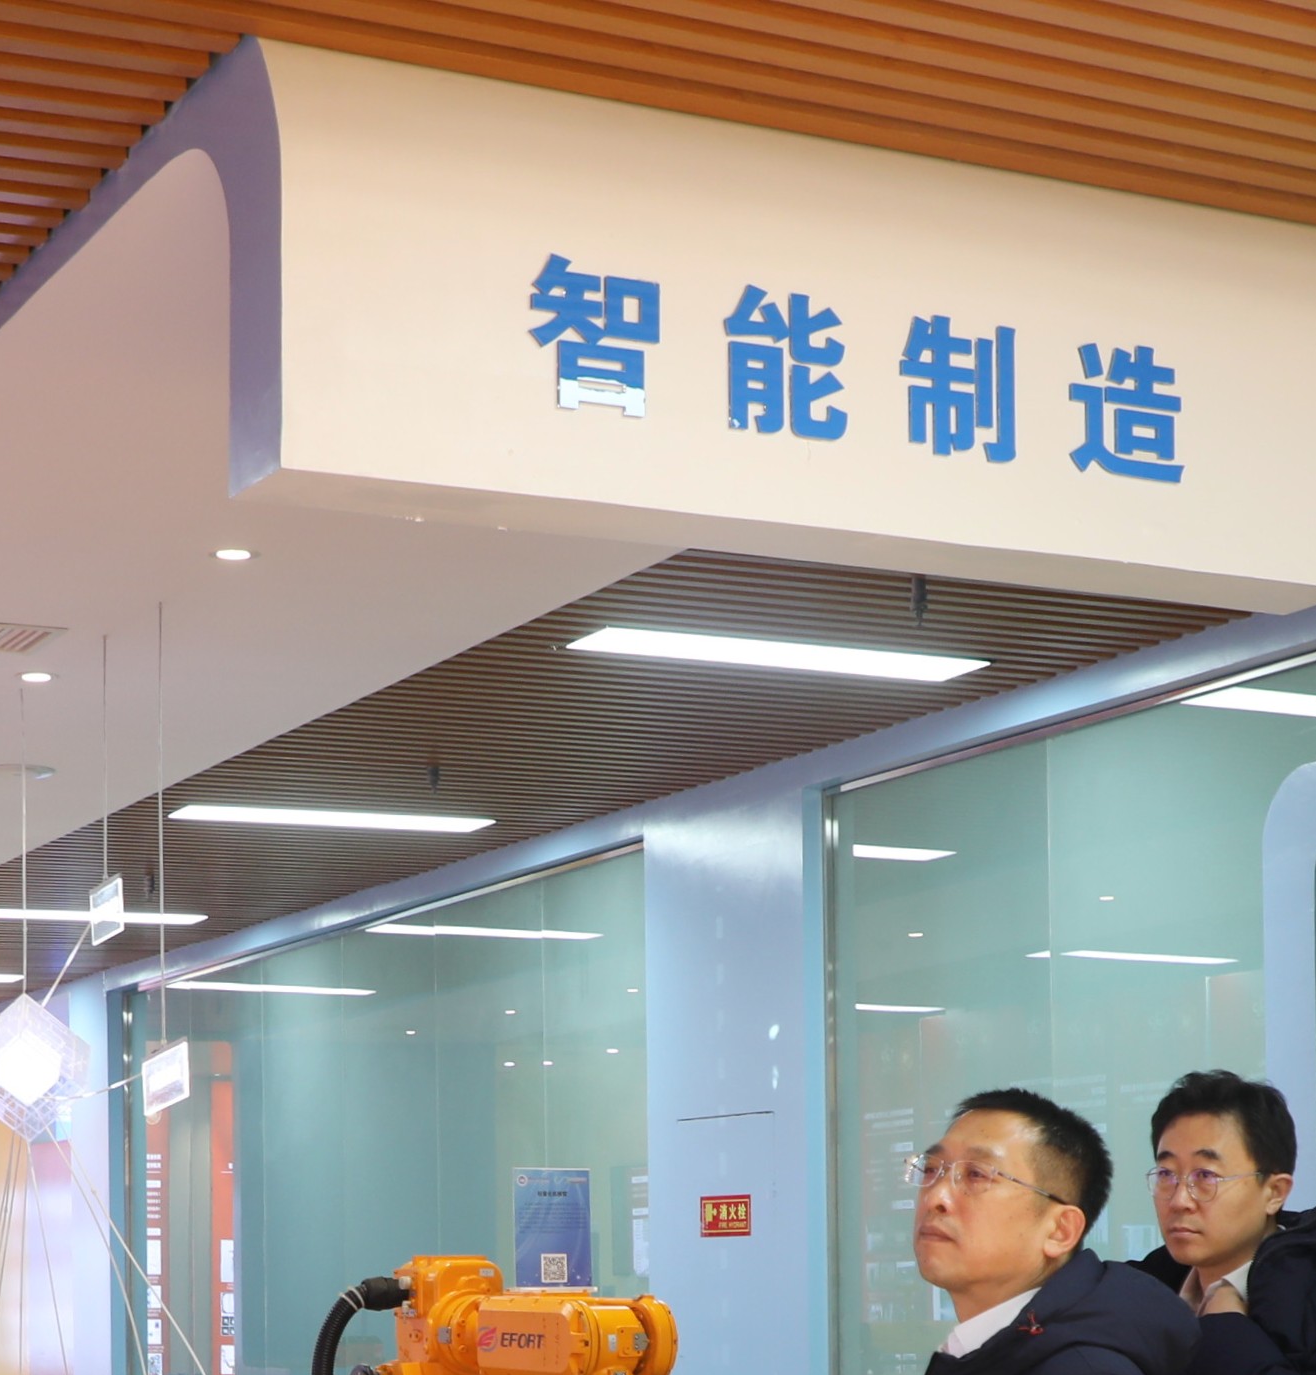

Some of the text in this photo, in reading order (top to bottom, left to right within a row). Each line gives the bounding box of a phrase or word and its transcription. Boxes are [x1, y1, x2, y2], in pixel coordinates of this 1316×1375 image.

[529, 253, 1185, 484] 智能制造
[719, 1203, 746, 1220] 消火栓
[500, 1332, 544, 1349] EFORT
